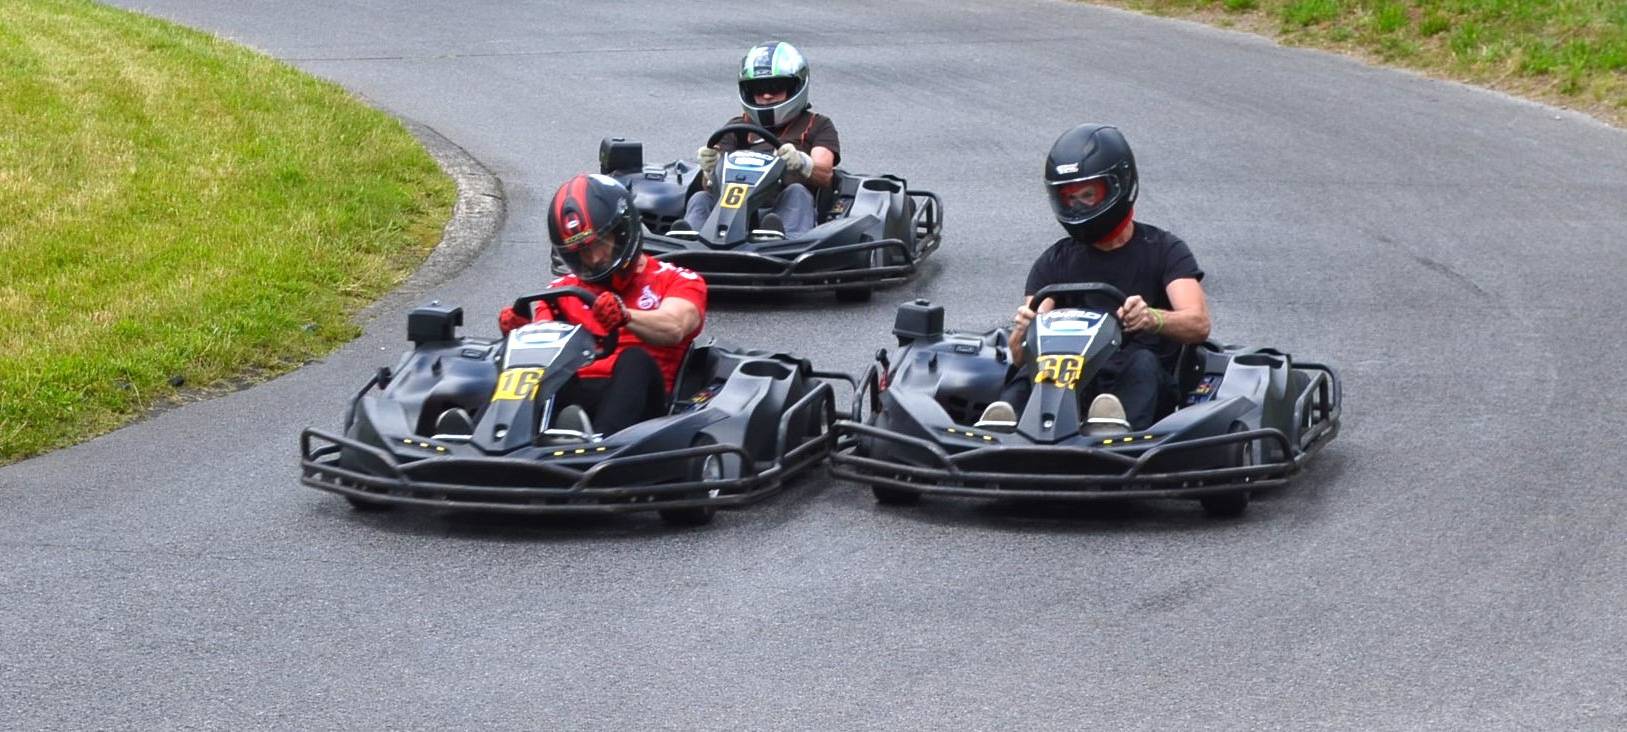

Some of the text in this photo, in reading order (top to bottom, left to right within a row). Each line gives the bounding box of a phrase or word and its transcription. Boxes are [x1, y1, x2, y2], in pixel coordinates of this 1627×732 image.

[725, 186, 743, 205] 6
[1038, 357, 1079, 384] 66
[502, 370, 541, 399] 16
